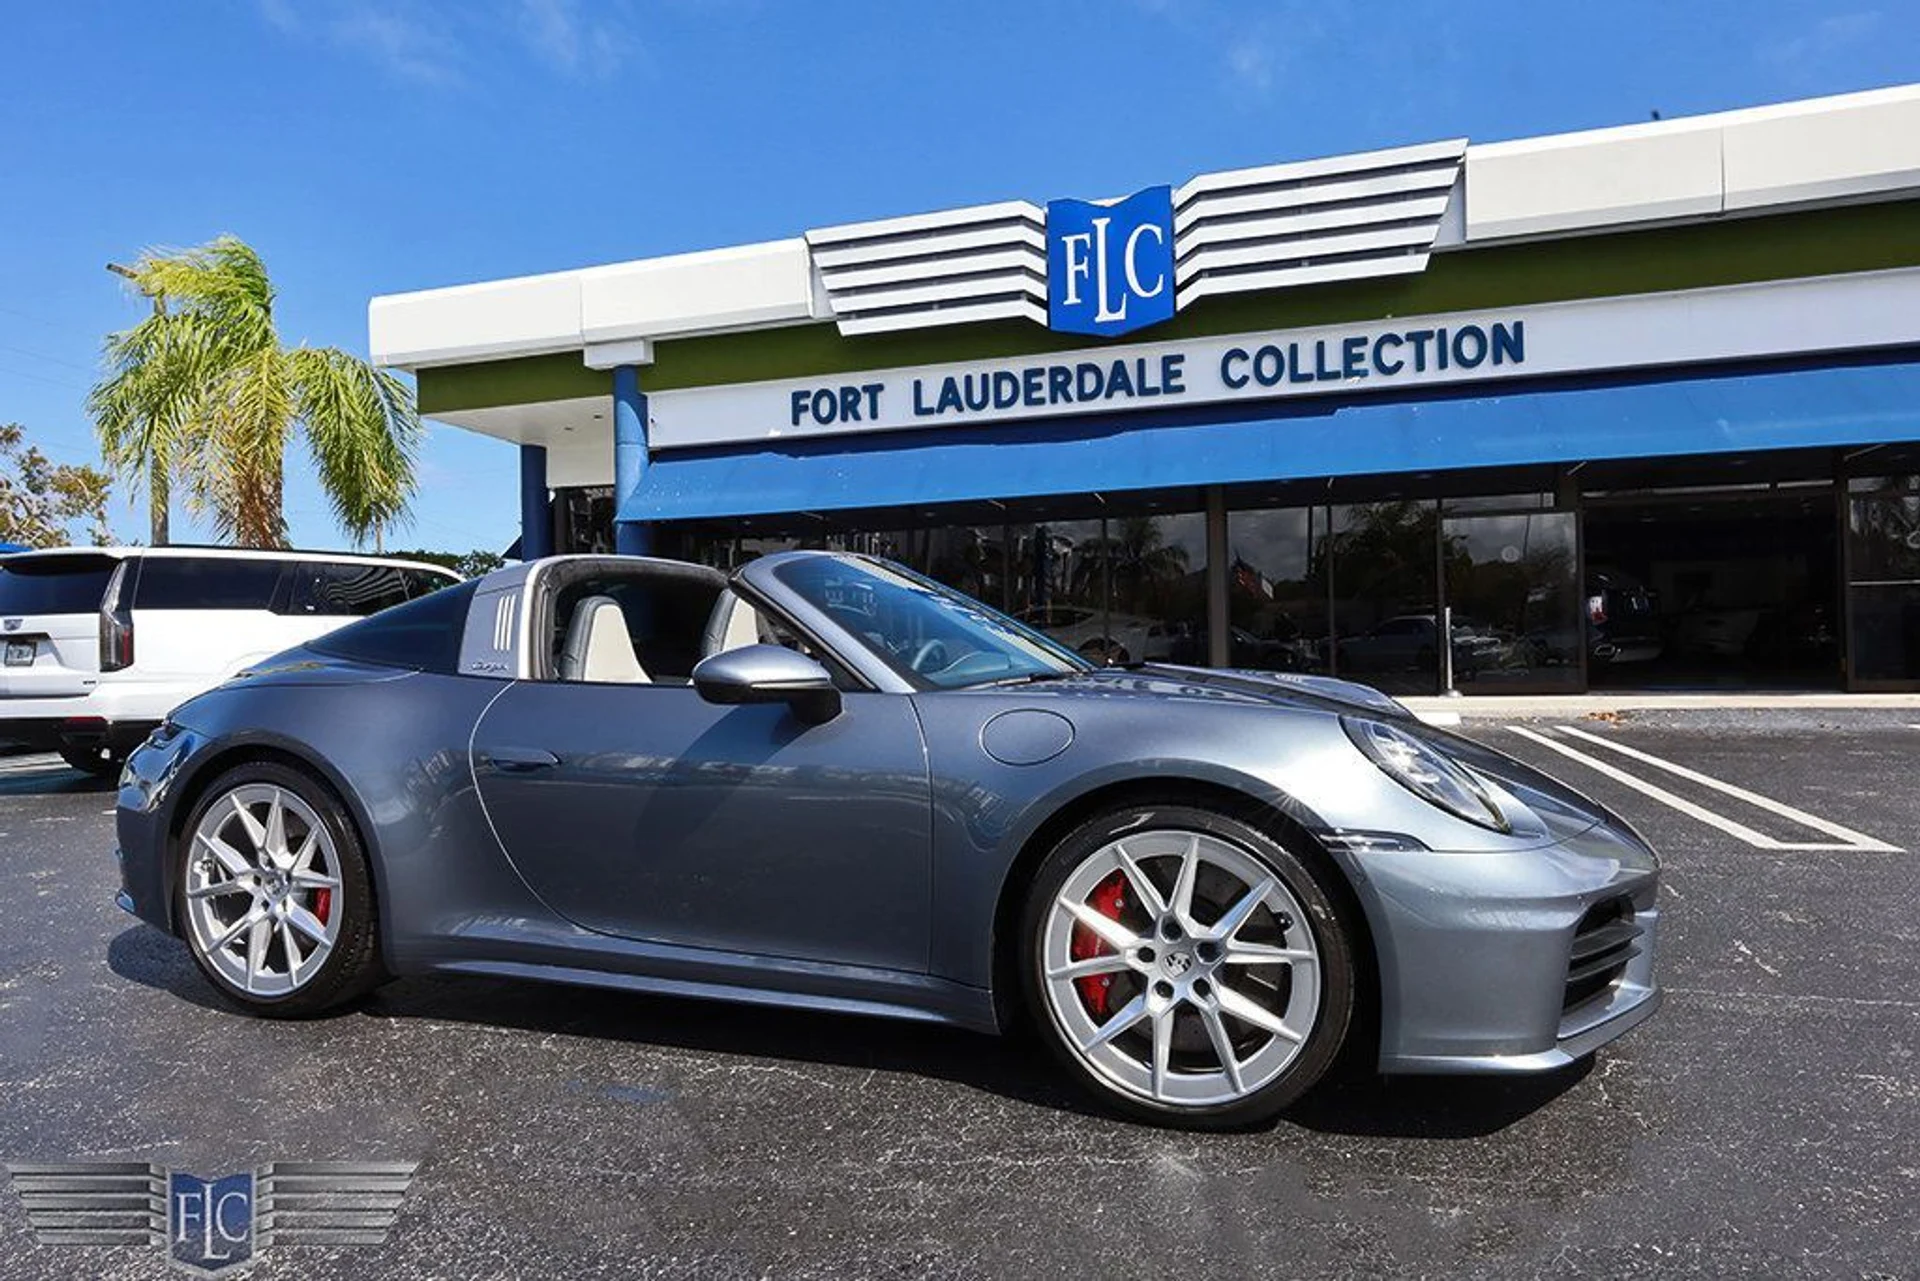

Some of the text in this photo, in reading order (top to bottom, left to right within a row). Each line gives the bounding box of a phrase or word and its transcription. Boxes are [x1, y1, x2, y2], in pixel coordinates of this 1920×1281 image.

[1061, 217, 1164, 323] FLC
[791, 320, 1525, 427] FORT LAUDERDALE COLLECTION
